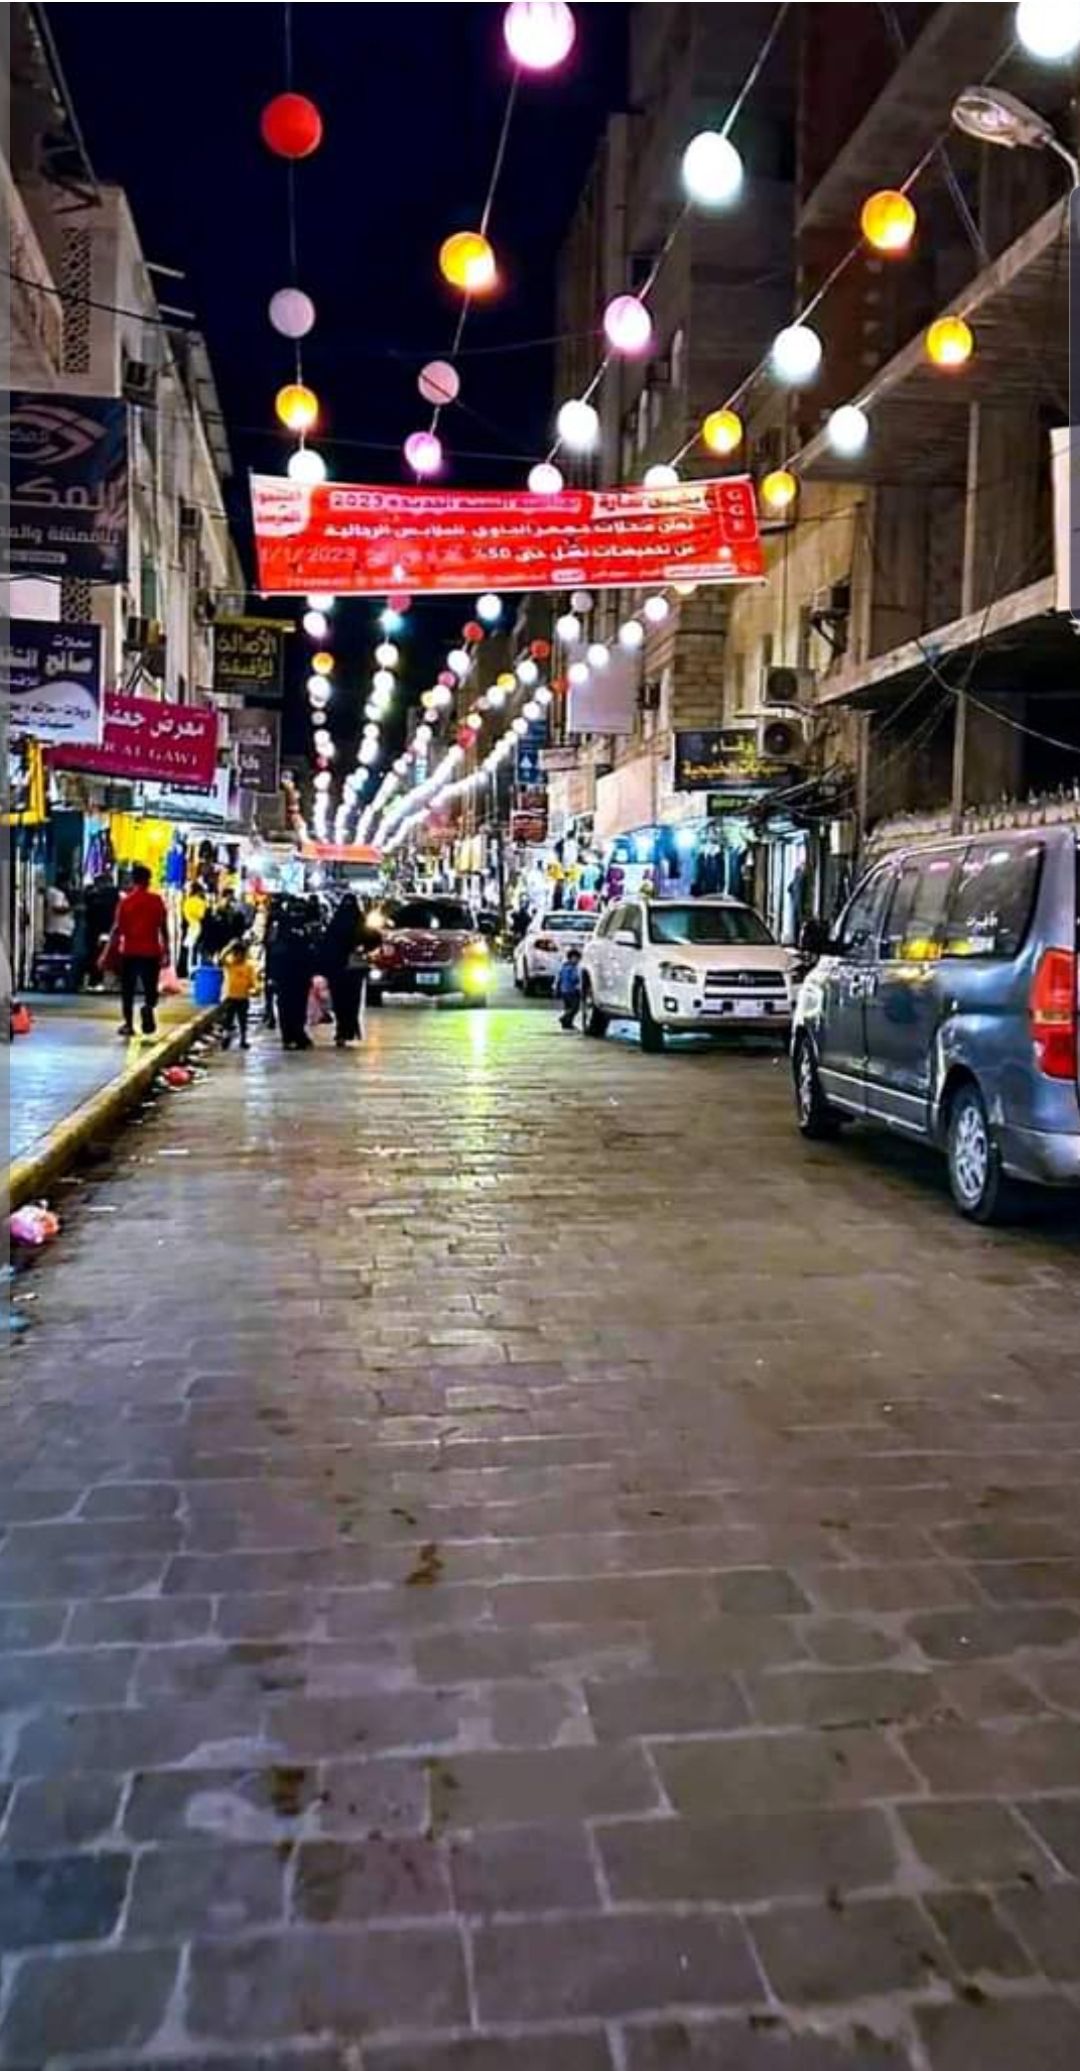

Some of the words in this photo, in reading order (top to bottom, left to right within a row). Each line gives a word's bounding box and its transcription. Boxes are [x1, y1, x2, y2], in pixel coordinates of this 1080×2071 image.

[333, 493, 383, 508] 2023
[44, 649, 93, 677] صالح
[149, 709, 205, 739] معرض
